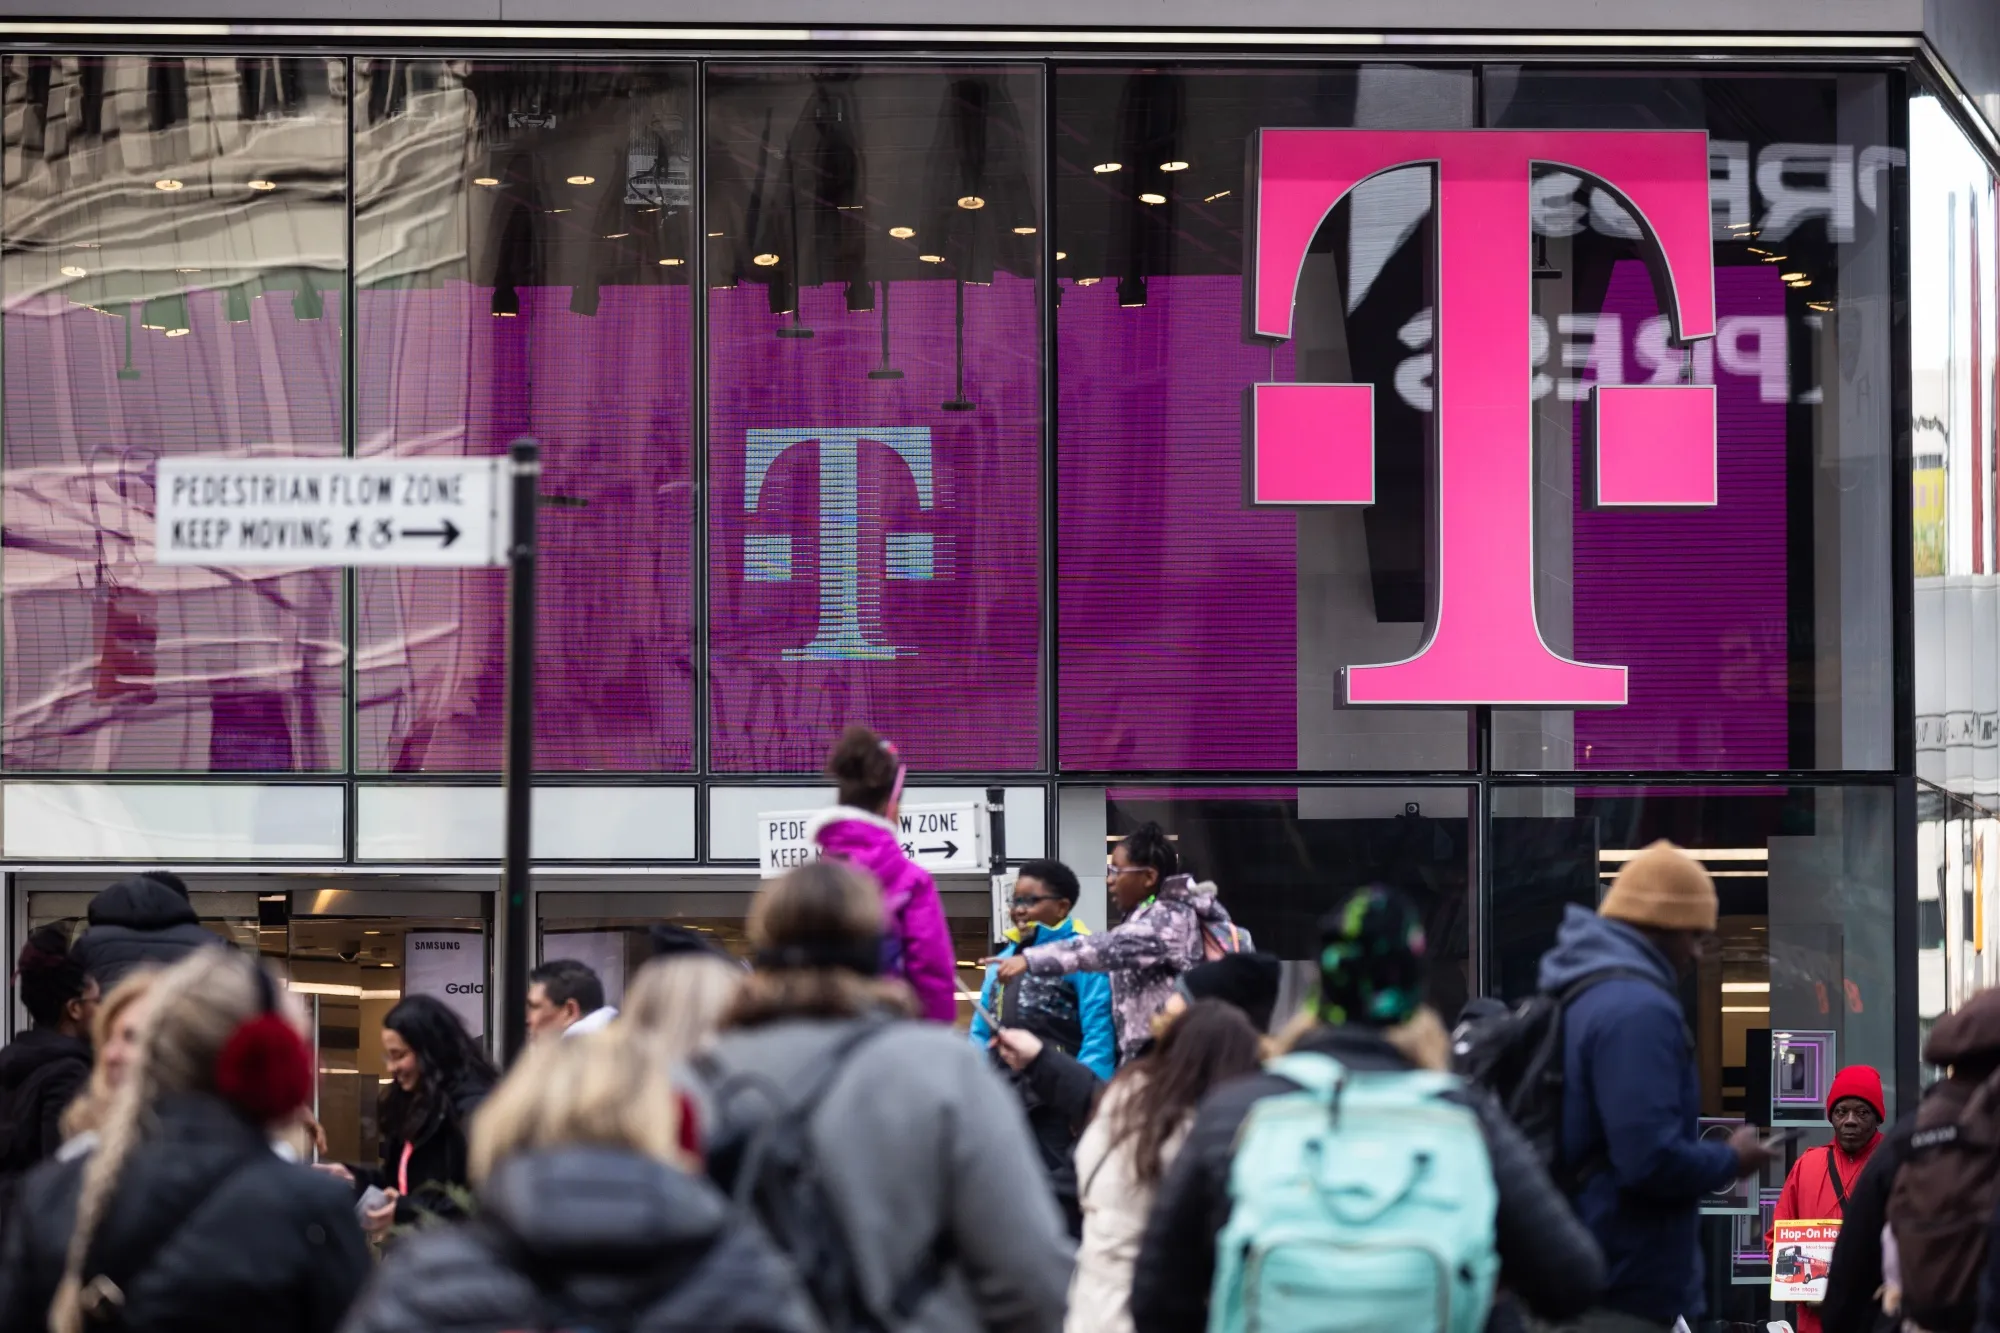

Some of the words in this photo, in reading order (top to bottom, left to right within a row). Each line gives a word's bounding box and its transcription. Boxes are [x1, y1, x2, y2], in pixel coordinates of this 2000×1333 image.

[1252, 127, 1717, 705] T
[171, 474, 321, 506] PEDESTRIAN
[328, 474, 393, 506] FLOW
[402, 473, 464, 506] ZONE
[171, 517, 231, 550] KEEP
[238, 517, 333, 550] MOVING
[744, 426, 934, 661] T
[769, 820, 807, 842] PEDE
[899, 814, 912, 834] W
[918, 812, 959, 833] ZONE
[770, 847, 809, 868] KEEP
[414, 941, 461, 950] SAMSUNG
[445, 982, 484, 995] Gala
[1780, 1228, 1821, 1242] Hop-On
[1823, 1227, 1840, 1239] Ho
